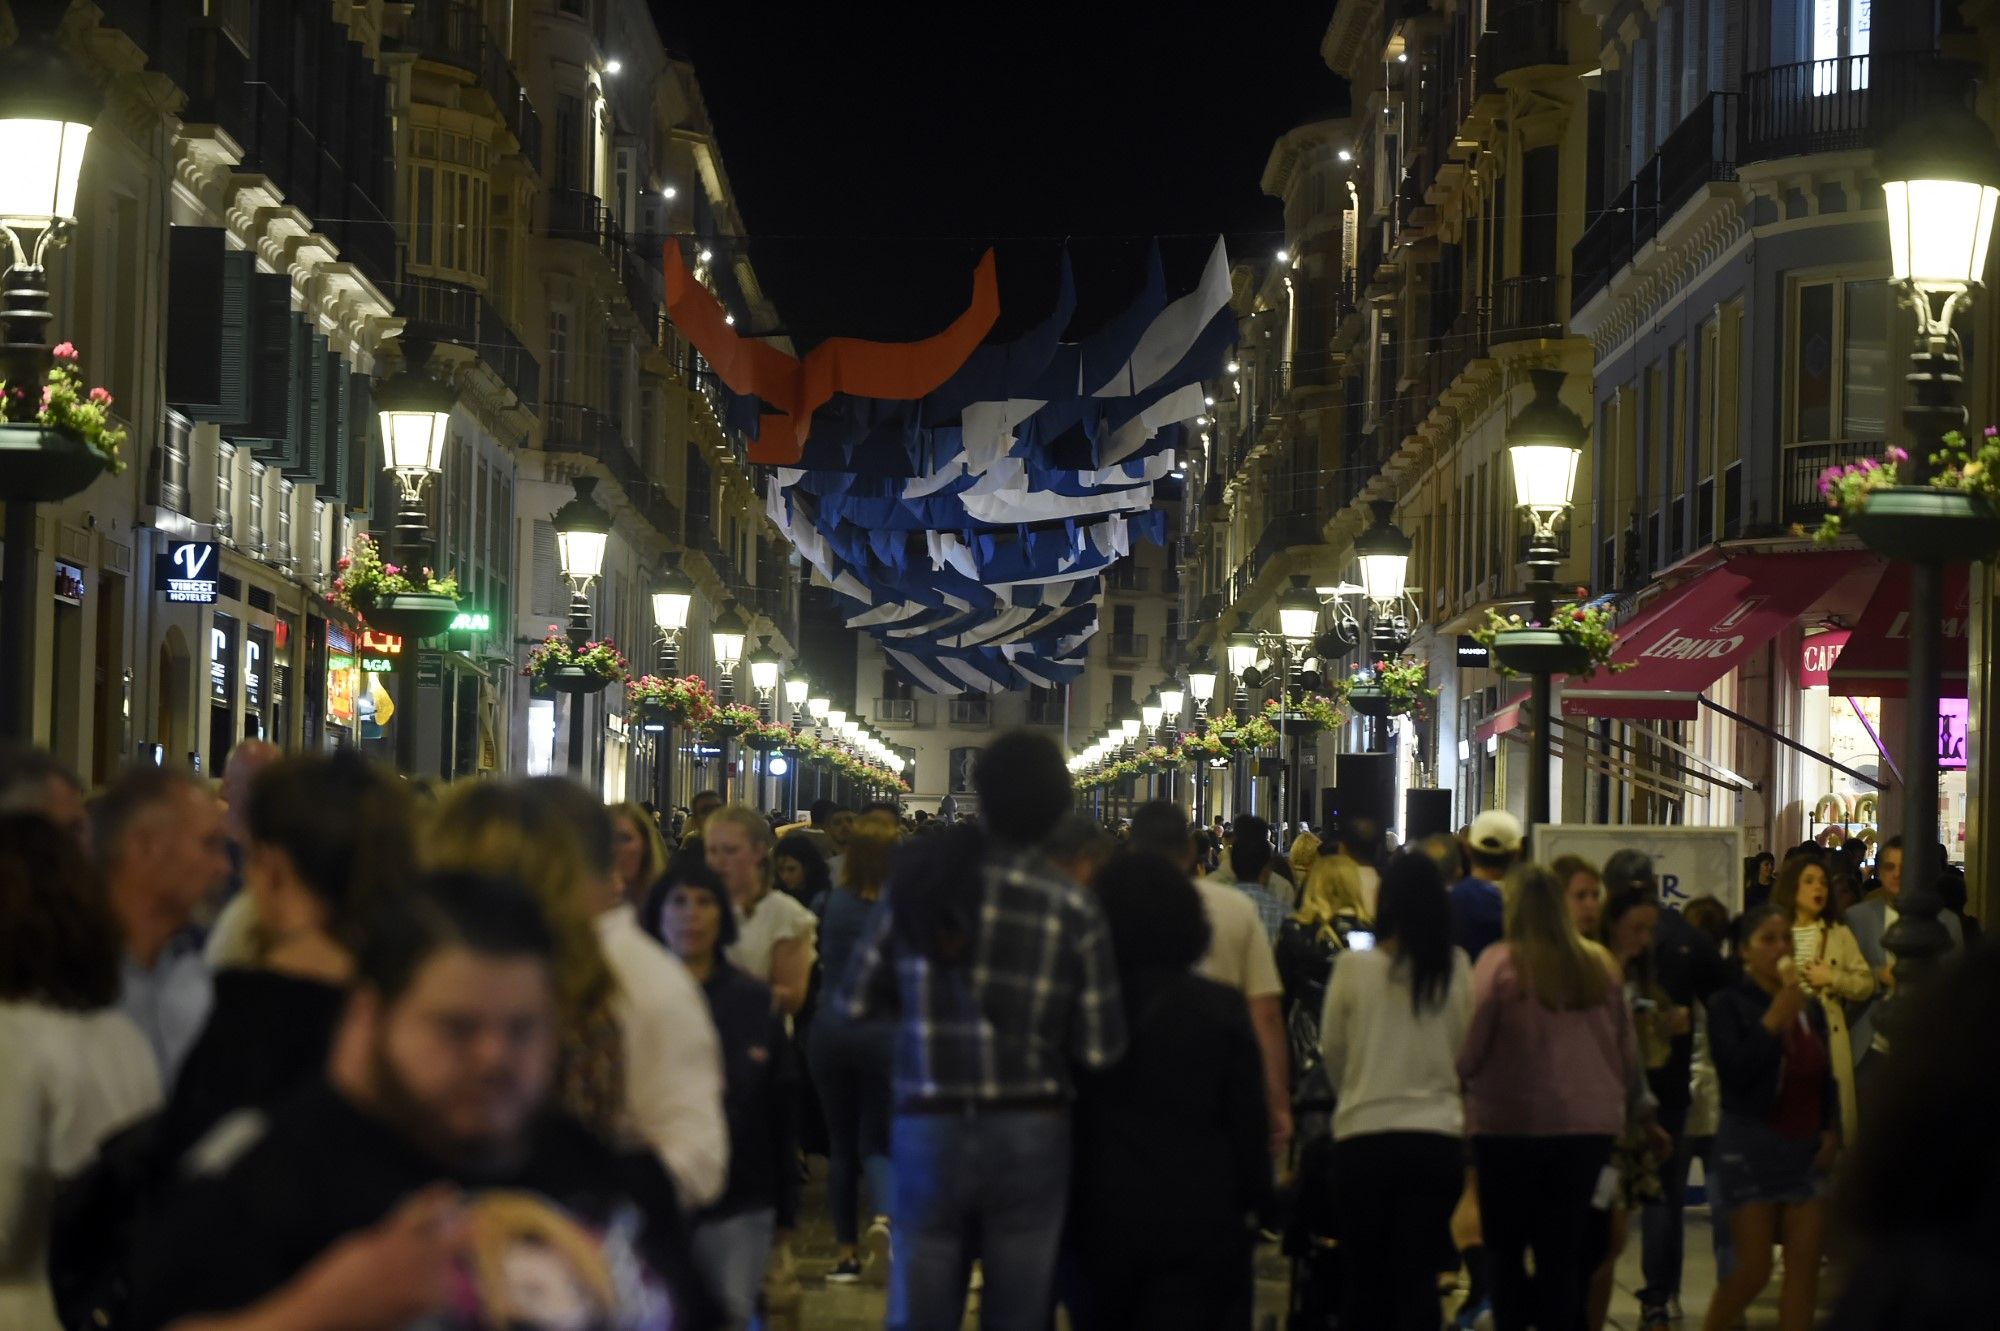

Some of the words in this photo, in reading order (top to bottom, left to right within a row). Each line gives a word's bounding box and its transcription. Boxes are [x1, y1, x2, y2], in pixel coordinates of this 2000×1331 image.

[173, 543, 212, 579] V
[170, 582, 213, 592] VINCCI
[170, 592, 212, 602] HOTELES
[1640, 628, 1744, 660] LEPANTO
